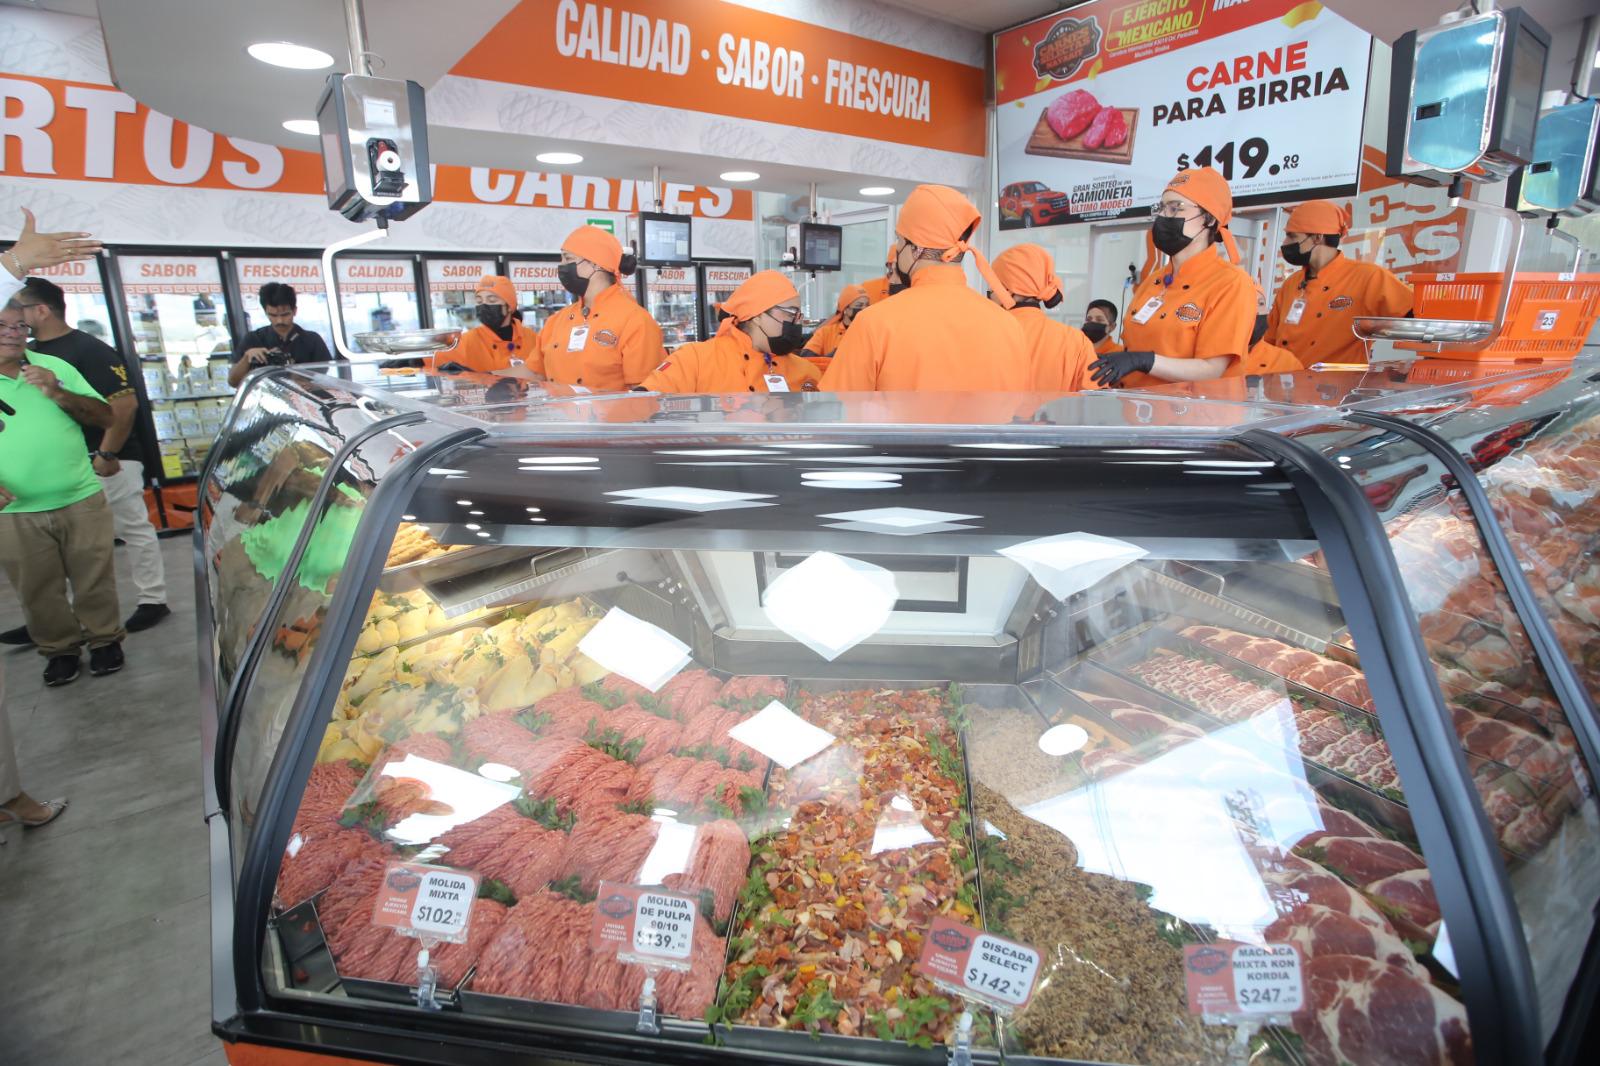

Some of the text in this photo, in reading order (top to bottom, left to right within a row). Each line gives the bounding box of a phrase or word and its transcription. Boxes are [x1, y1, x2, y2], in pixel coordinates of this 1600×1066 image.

[1118, 11, 1193, 46] MEXICANO
[555, 0, 931, 122] CALIDAD SABOR FRESCURA
[1186, 40, 1309, 93] CARNE
[1152, 67, 1350, 127] PARA BIRRIA
[1073, 184, 1091, 192] GRAN
[1091, 180, 1118, 190] SORTEO
[1071, 186, 1133, 204] CAMIONETA
[1099, 199, 1133, 210] MODELO
[140, 263, 198, 277] SABOR
[243, 264, 319, 278] FRESCURA
[348, 265, 404, 278] CALIDAD
[442, 265, 483, 277] SABOR
[513, 266, 559, 278] FRESCUR
[708, 271, 749, 280] FRESCURA
[1542, 316, 1554, 326] 23
[429, 877, 466, 890] MOLIDA
[428, 889, 460, 901] MIXTA
[647, 895, 688, 909] MOLIDA
[640, 906, 655, 916] DE
[657, 909, 692, 921] PULPA
[650, 920, 679, 932] 90/10
[981, 940, 1034, 964] DISCADA
[981, 952, 1028, 974] SELECT
[1232, 959, 1295, 969] MIXTA KON
[1247, 971, 1290, 981] KORDIA
